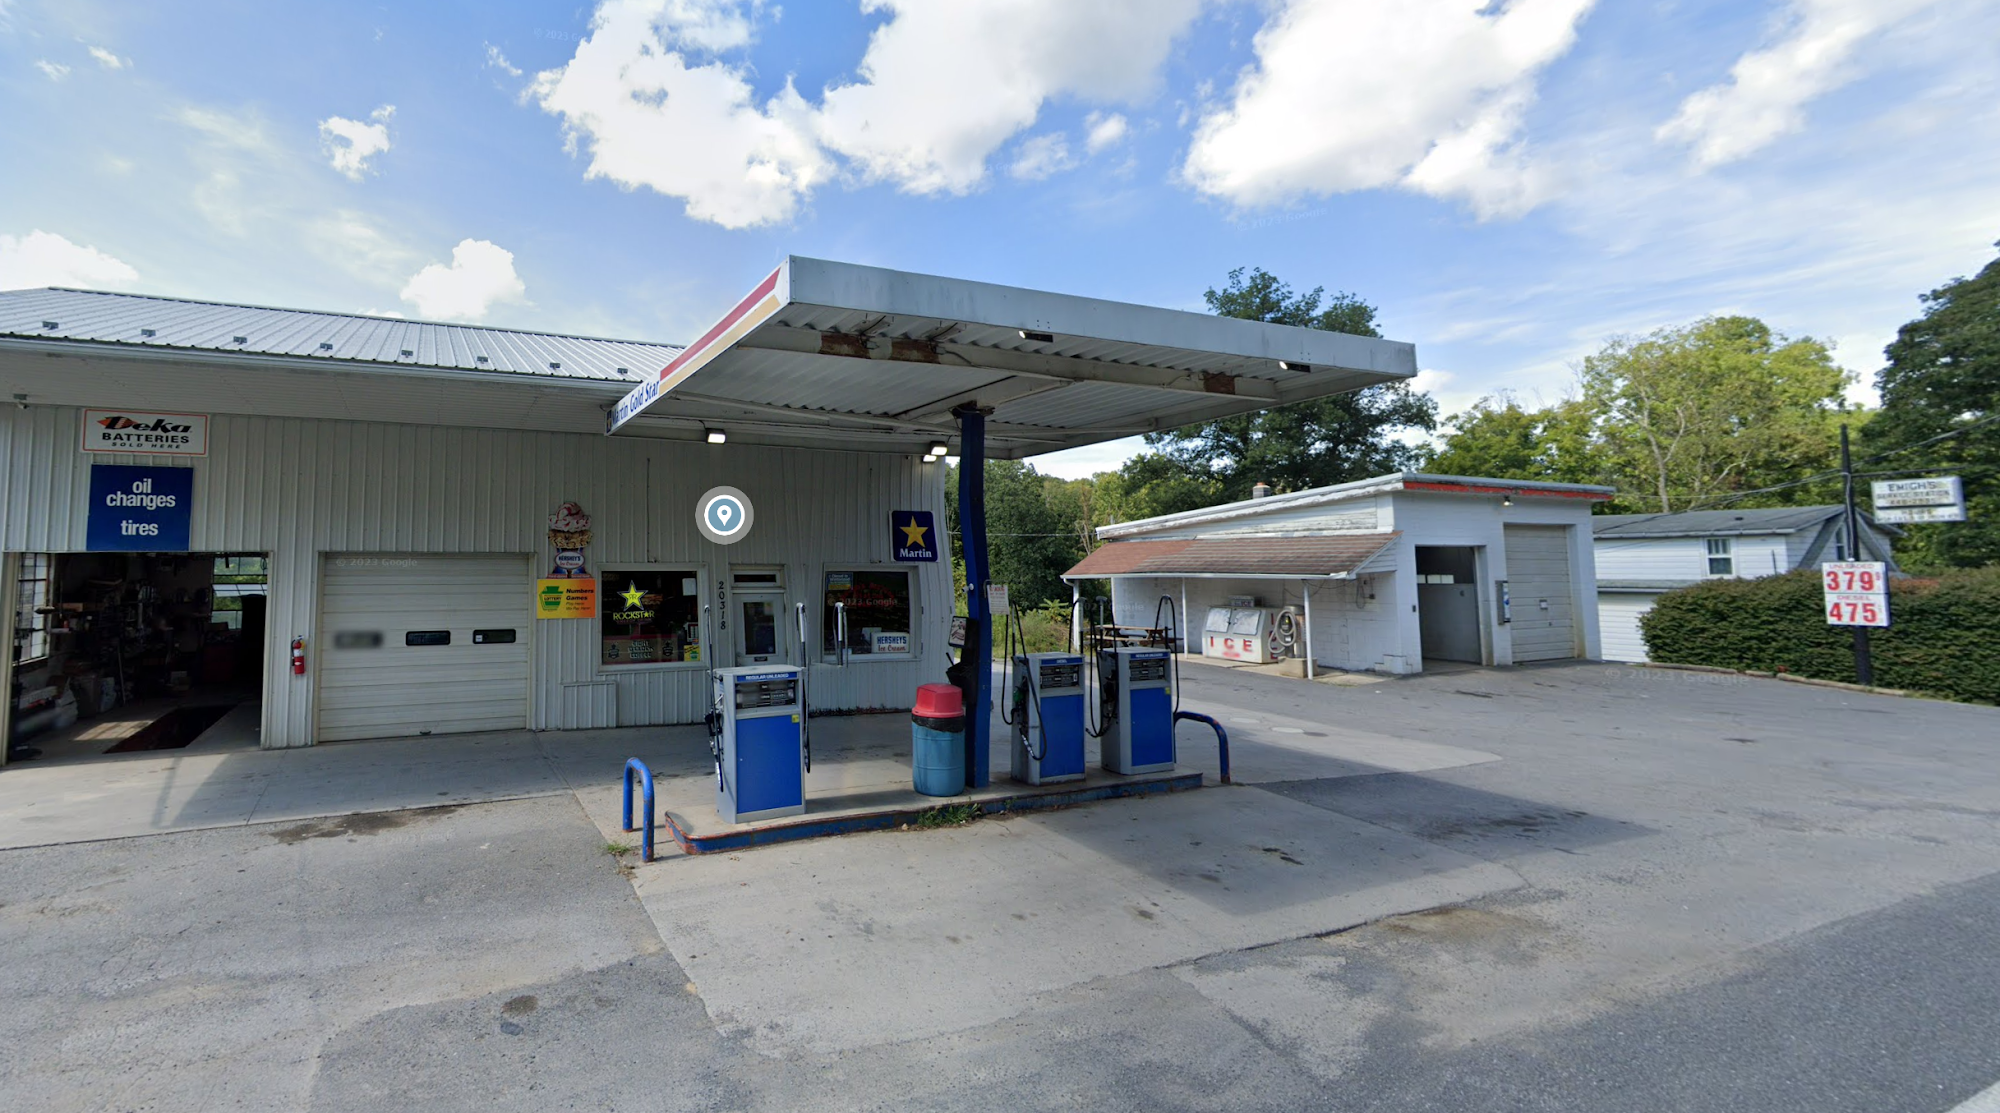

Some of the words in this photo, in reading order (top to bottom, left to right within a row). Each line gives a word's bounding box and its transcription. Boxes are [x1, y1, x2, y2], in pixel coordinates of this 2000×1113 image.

[630, 386, 644, 412] Gold
[645, 381, 660, 402] Star
[98, 416, 192, 434] Deka
[102, 432, 190, 444] BATTERIES
[132, 478, 152, 494] oil
[106, 491, 176, 510] changes
[121, 520, 158, 536] tires
[900, 548, 932, 558] Martin
[1826, 570, 1874, 591] 379
[1829, 602, 1878, 623] 475
[1210, 636, 1253, 652] ICE
